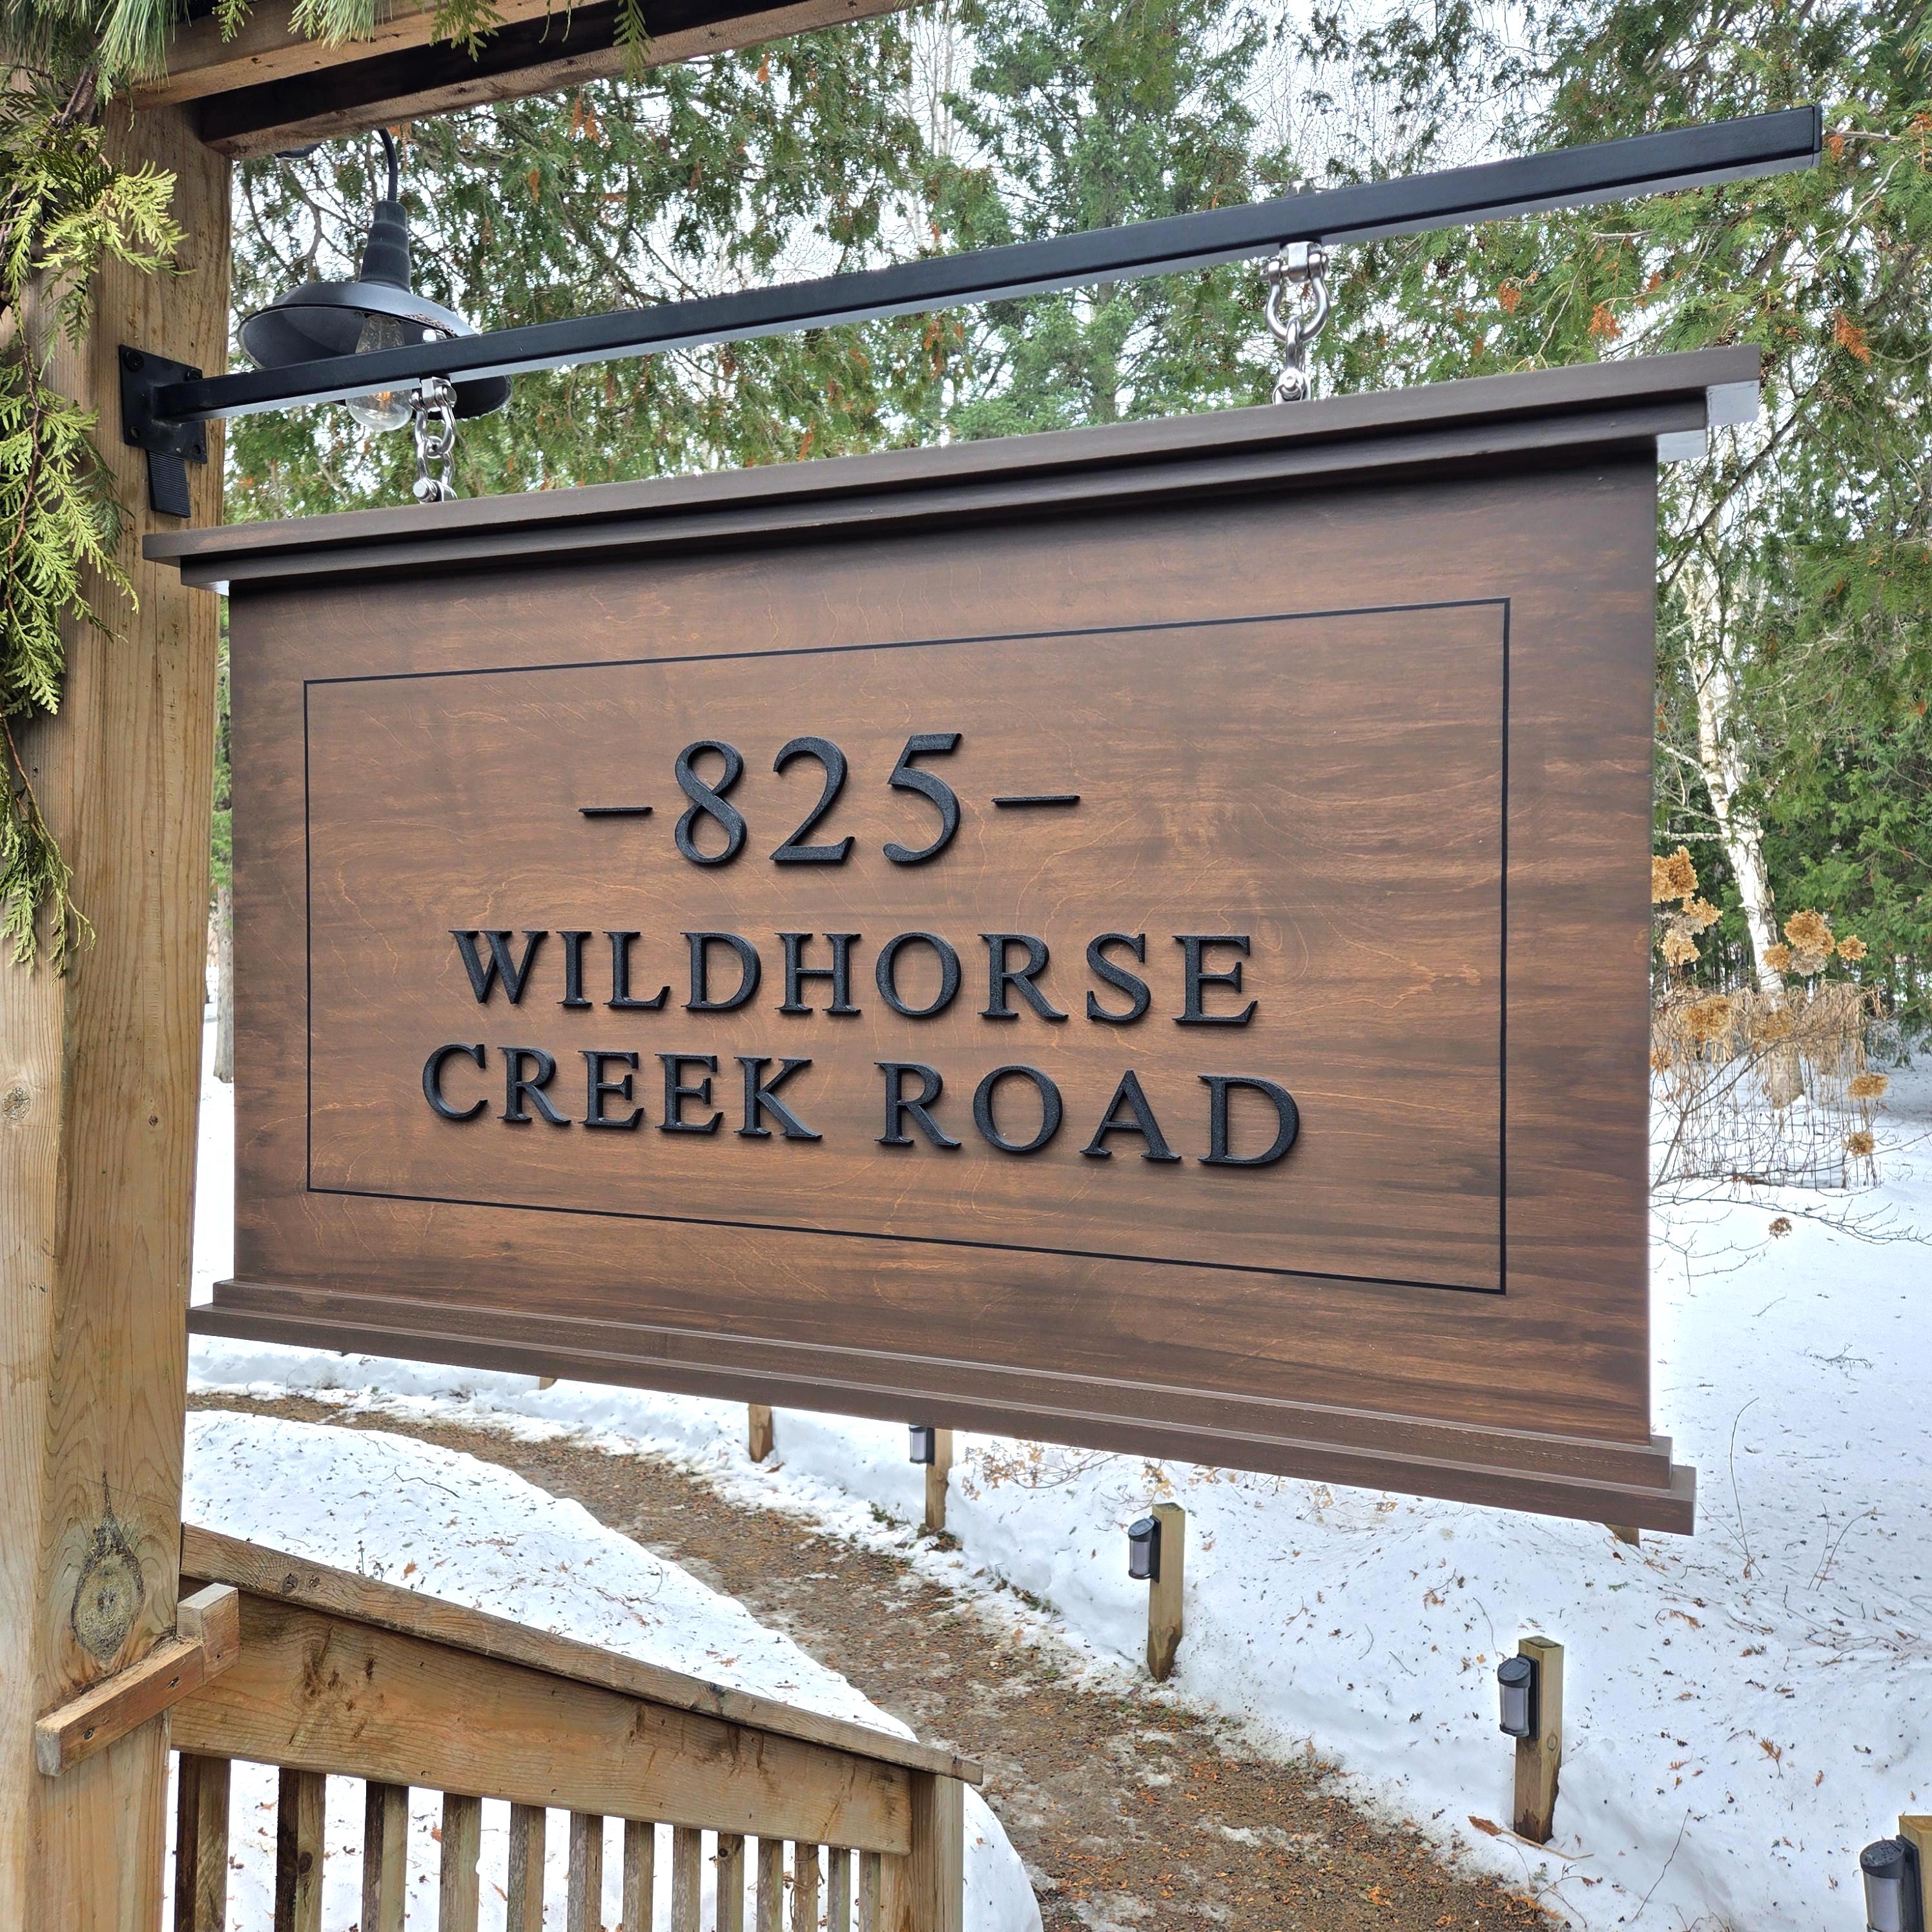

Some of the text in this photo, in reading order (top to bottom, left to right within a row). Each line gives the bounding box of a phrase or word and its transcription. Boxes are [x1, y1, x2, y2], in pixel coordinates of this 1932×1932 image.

[448, 929, 1258, 1026] WILDHORSE
[421, 1043, 1301, 1166] CREEK ROAD
